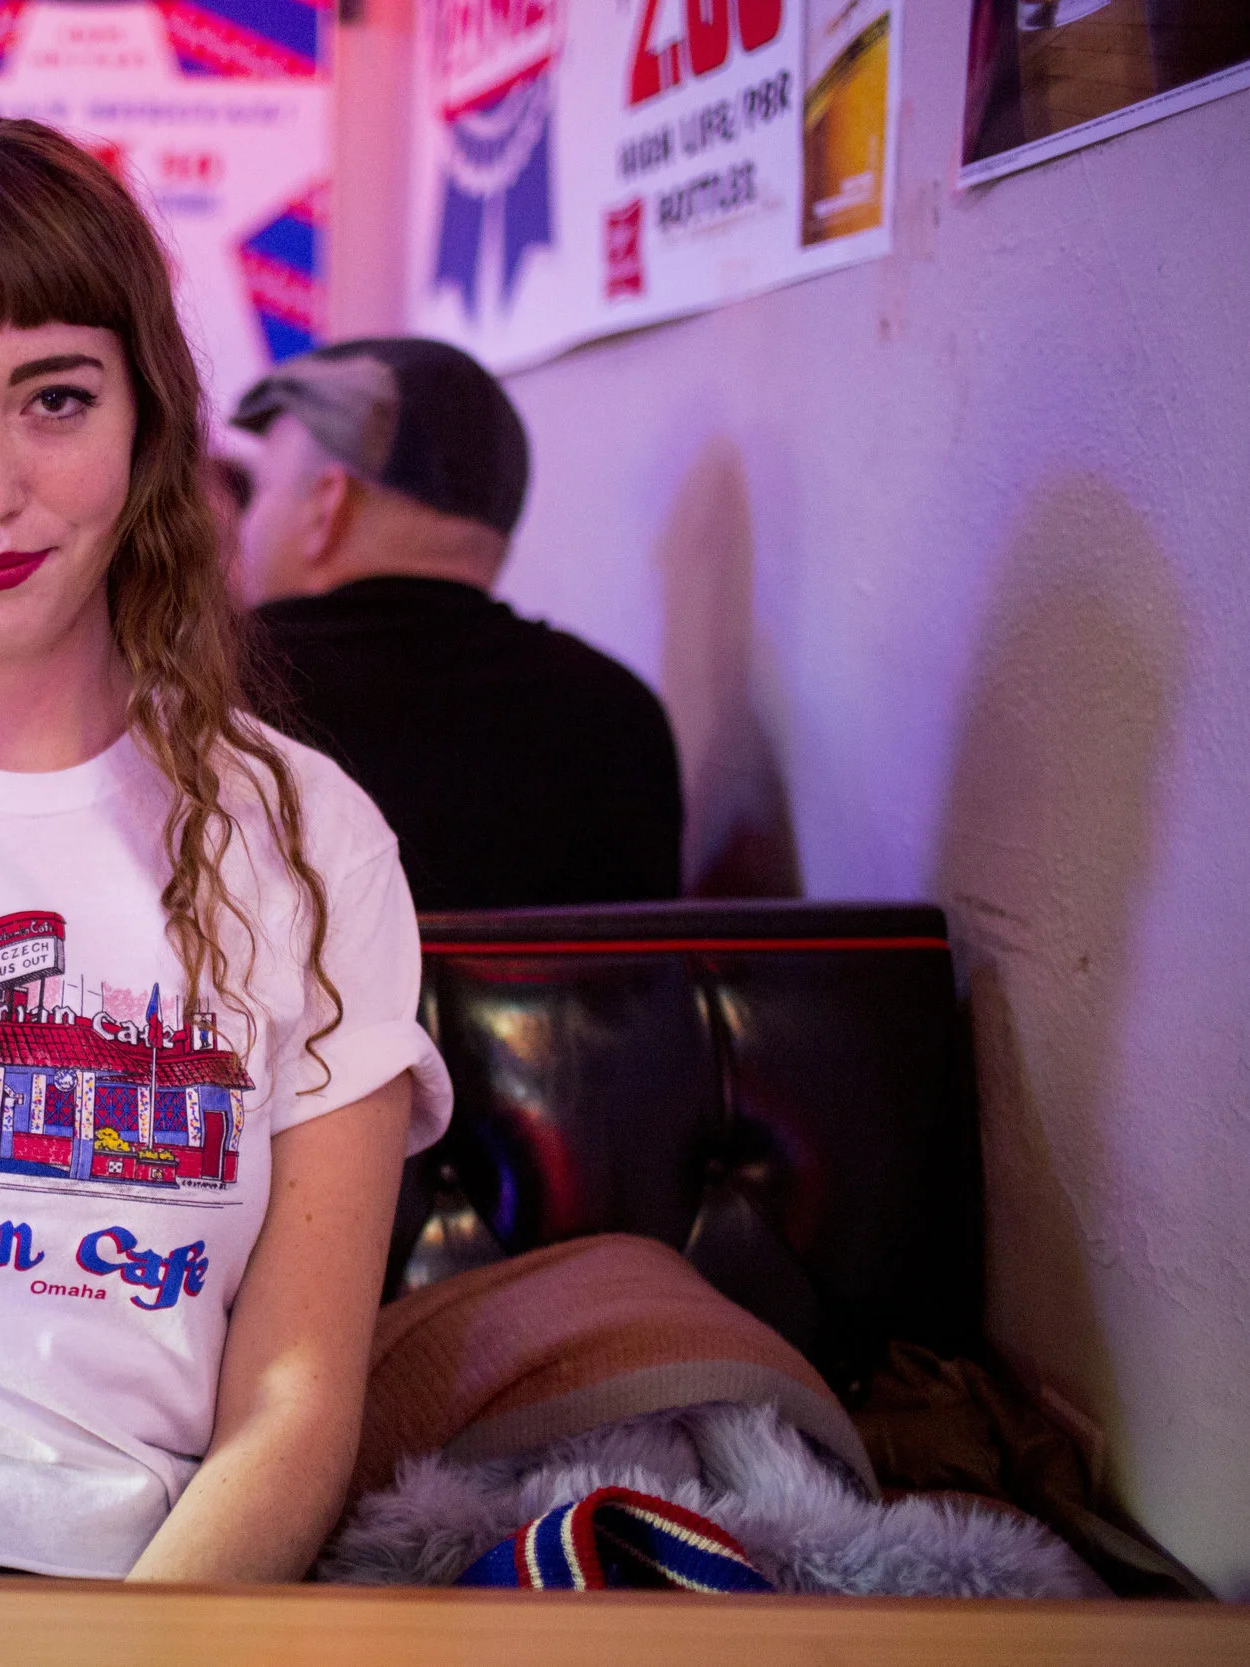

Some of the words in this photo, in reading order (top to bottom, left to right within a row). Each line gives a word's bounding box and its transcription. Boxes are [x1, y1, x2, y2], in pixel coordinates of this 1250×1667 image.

[0, 942, 49, 961] CZECH
[22, 954, 49, 968] OUT
[75, 1226, 210, 1311] Cafe
[30, 1280, 107, 1301] Omaha
